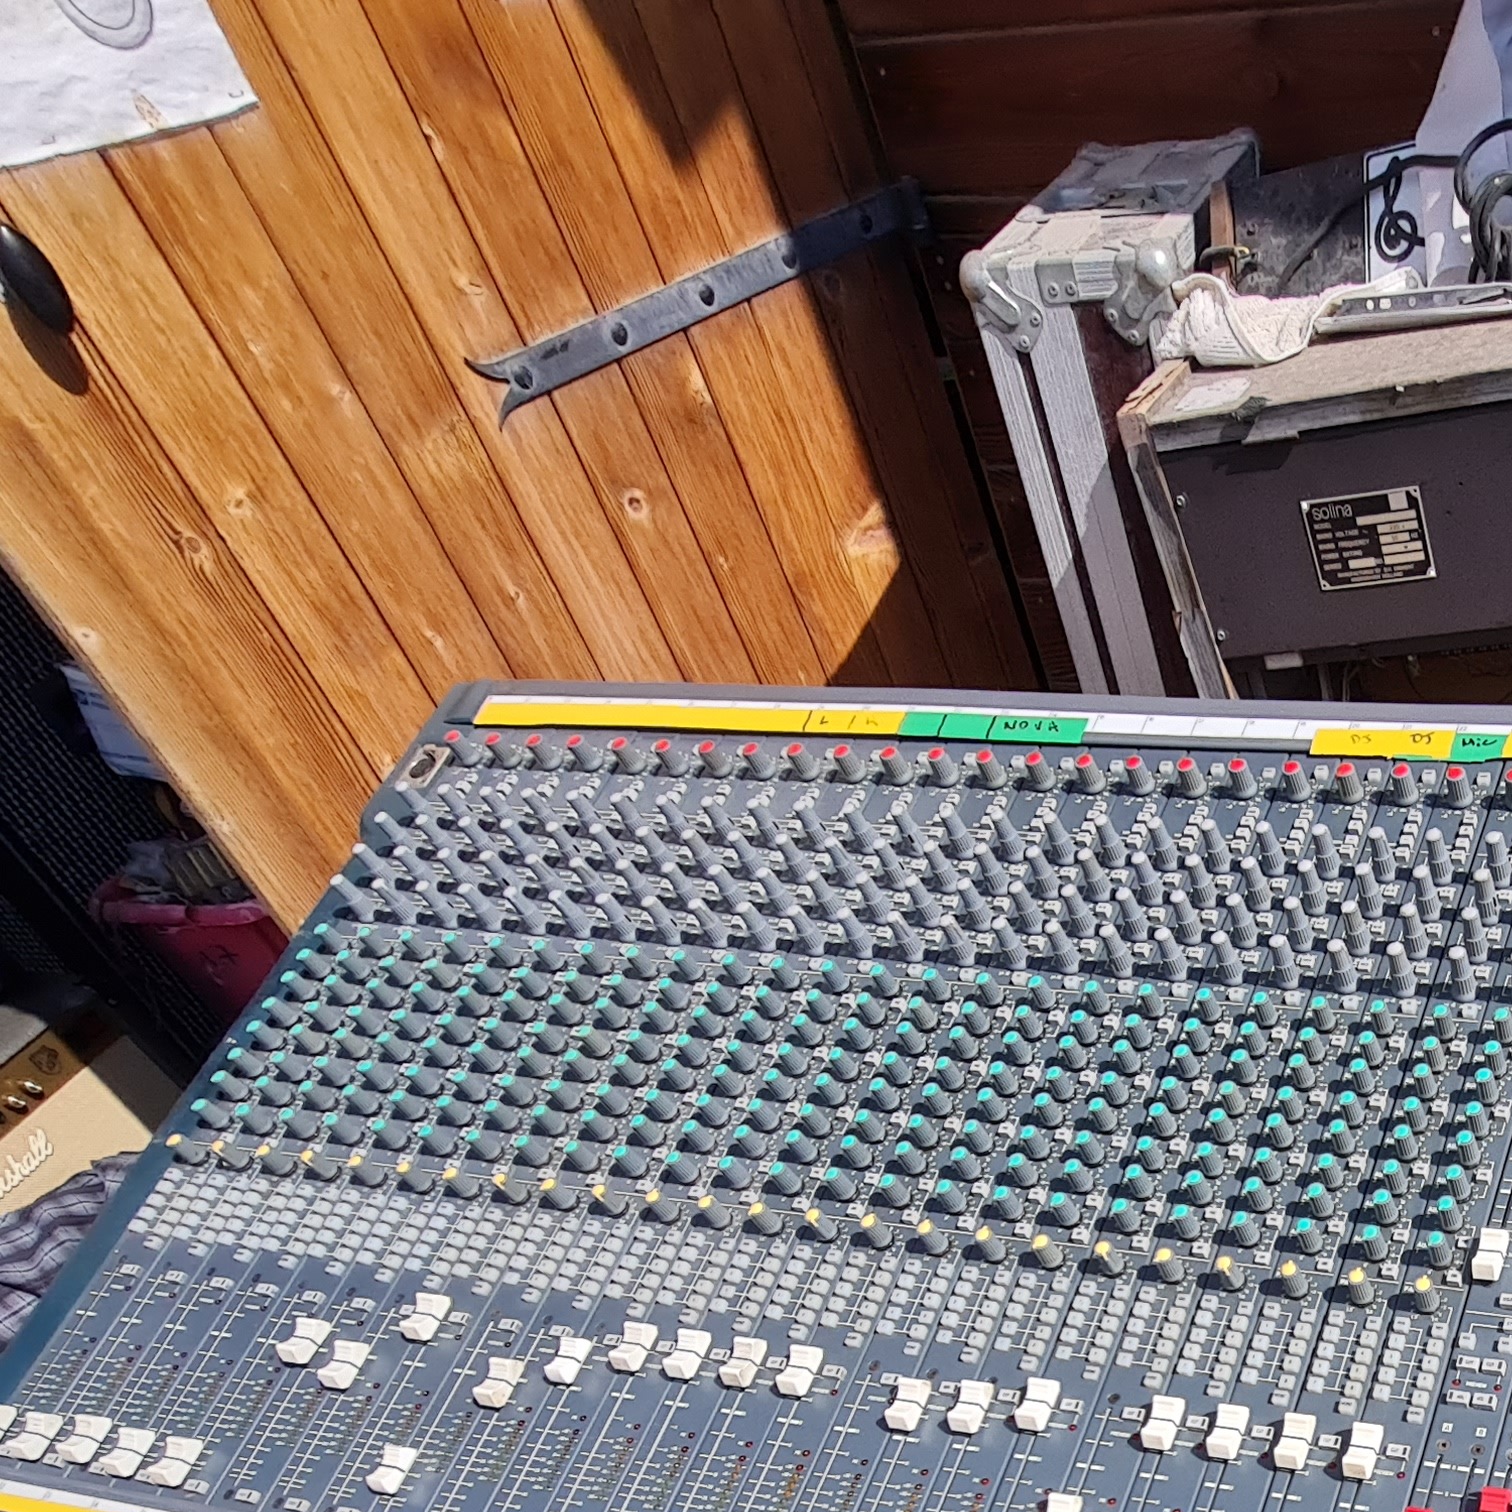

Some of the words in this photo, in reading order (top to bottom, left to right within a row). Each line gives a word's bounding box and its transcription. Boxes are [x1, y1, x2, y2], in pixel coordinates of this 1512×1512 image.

[1312, 503, 1353, 521] solina
[1003, 719, 1060, 732] NOVA
[0, 1127, 54, 1198] shall
